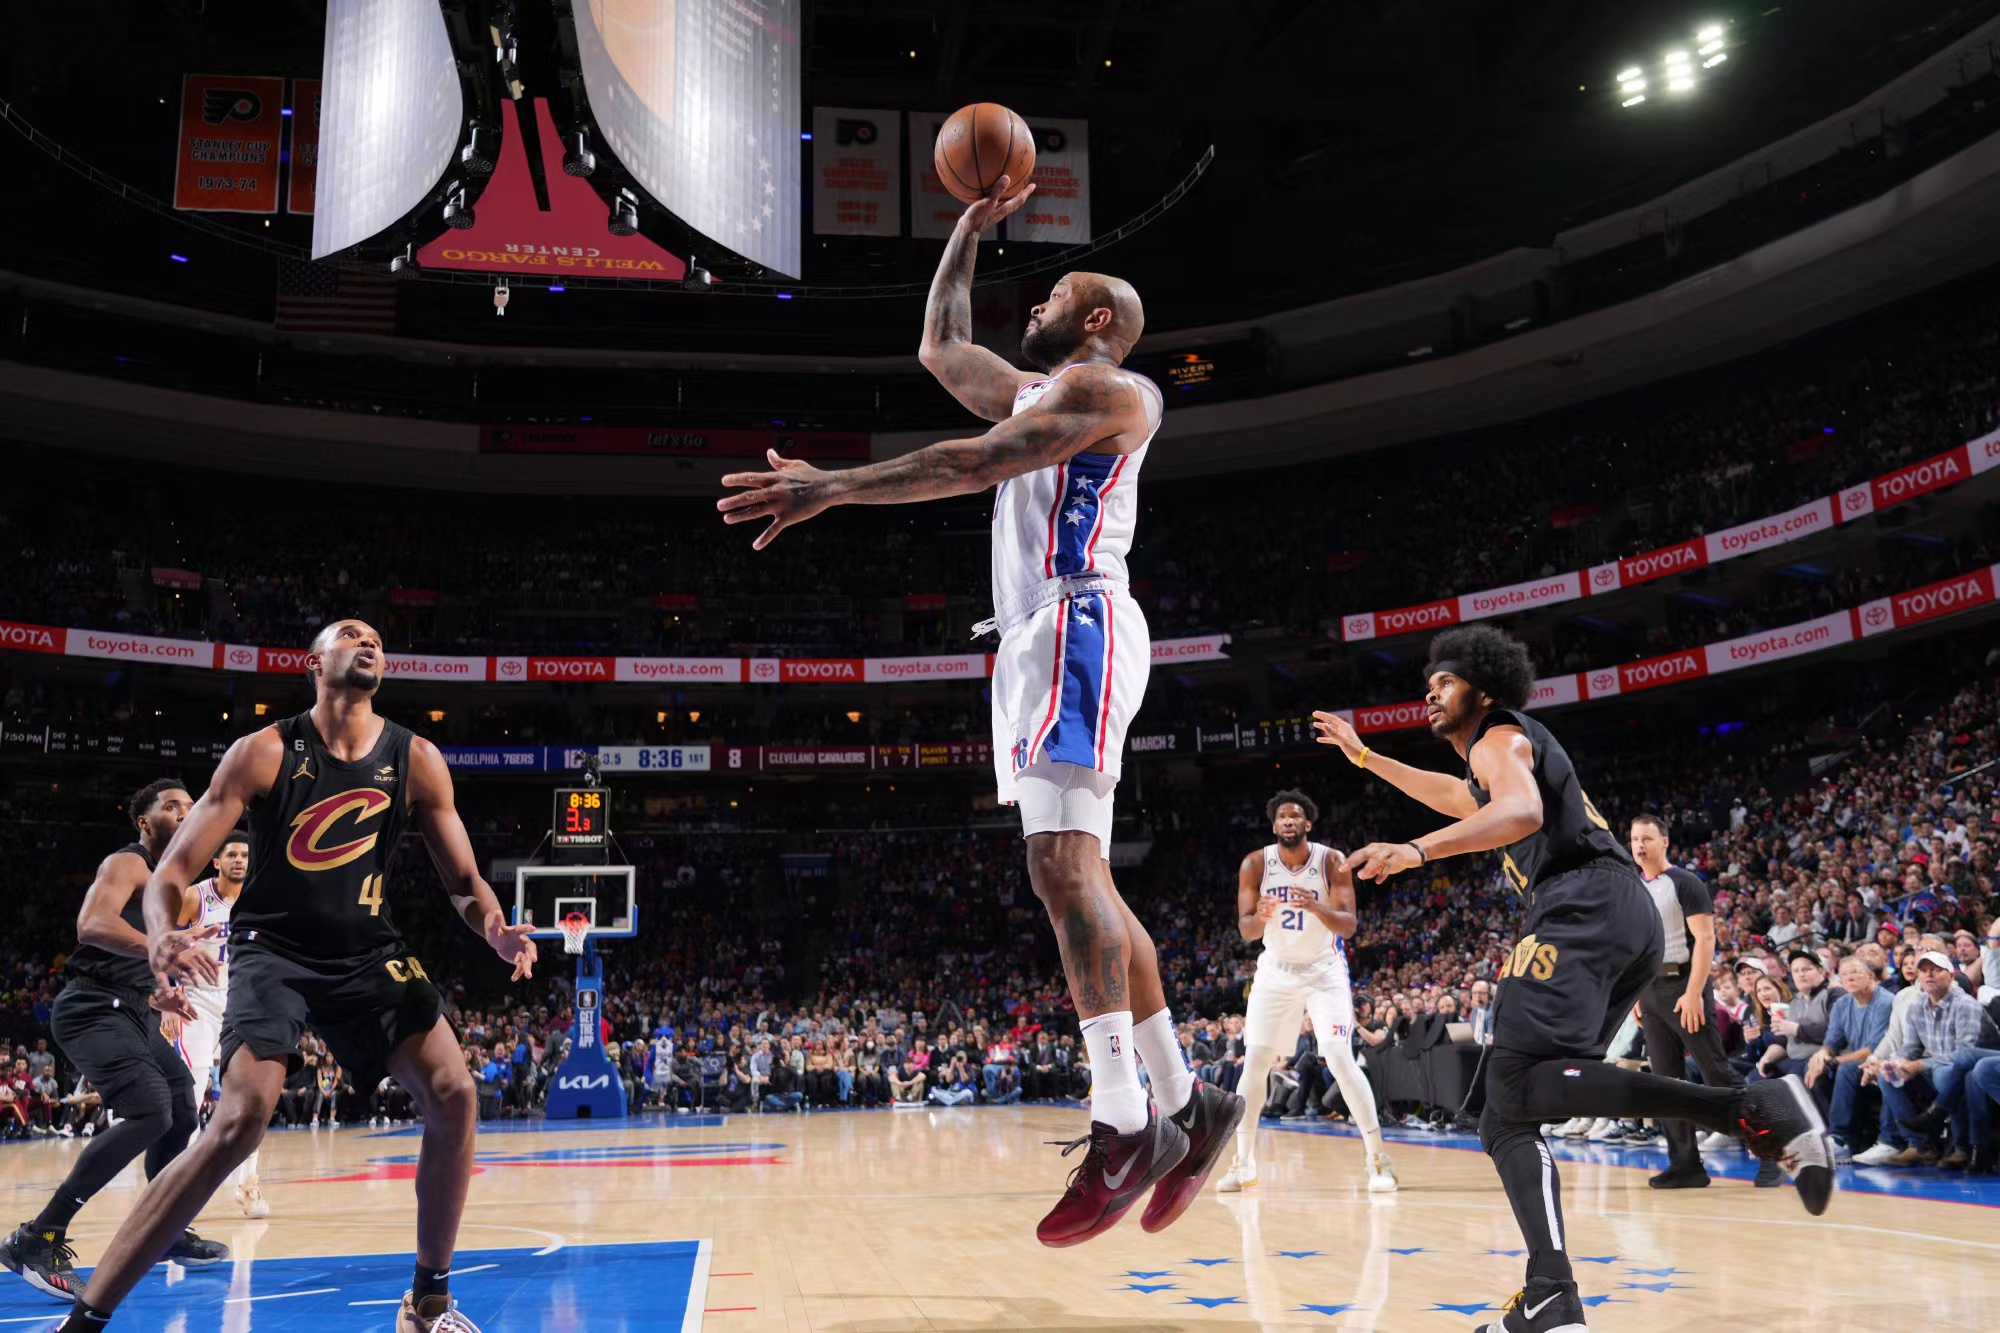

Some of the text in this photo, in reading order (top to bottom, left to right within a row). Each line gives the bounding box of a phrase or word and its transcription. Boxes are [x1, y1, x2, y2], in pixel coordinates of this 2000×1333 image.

[189, 137, 271, 152] STANLEY CUP
[191, 150, 266, 164] CHAMPIONS
[197, 176, 257, 192] 1973-74
[505, 243, 600, 257] CENTER
[442, 248, 665, 271] WELLS FARGO
[1168, 363, 1215, 376] RIVERS
[681, 431, 703, 447] Go
[1879, 456, 1960, 500] TOYOTA
[1720, 511, 1819, 551] toyota.com
[1624, 546, 1697, 579] TOYOTA
[1472, 581, 1566, 613] toyota.com
[1898, 579, 1983, 617] TOYOTA
[1380, 605, 1451, 629] TOYOTA
[0, 625, 307, 667] YOTA toyota.com TOY
[1730, 625, 1830, 660] toyota.com
[384, 642, 1211, 678] oyota.com TOYOTA toyota.com TOYOTA toyota.com ota.com
[1624, 655, 1697, 685] TOYOTA
[26, 733, 42, 744] PM
[294, 739, 305, 751] 6
[1130, 733, 1176, 751] MARCH 2
[1220, 733, 1234, 741] PM
[502, 752, 535, 765] 76ERS
[639, 749, 683, 768] 8:36
[728, 749, 741, 768] 8
[769, 752, 865, 764] CLEVELAND CAVALIERS
[920, 746, 948, 755] PLAYER
[1011, 738, 1028, 773] 76
[688, 754, 704, 764] 1ST
[882, 755, 889, 766] 1
[901, 755, 909, 766] 7
[920, 756, 948, 765] POINTS
[569, 792, 601, 809] 8:36
[566, 807, 591, 832] 3.3
[286, 787, 392, 871] C
[570, 835, 604, 843] TISSOT
[358, 872, 384, 916] 4
[1281, 909, 1304, 931] 21
[579, 1010, 595, 1023] GET
[580, 1024, 595, 1035] THE
[1333, 1025, 1347, 1037] 76
[578, 1035, 595, 1049] APP
